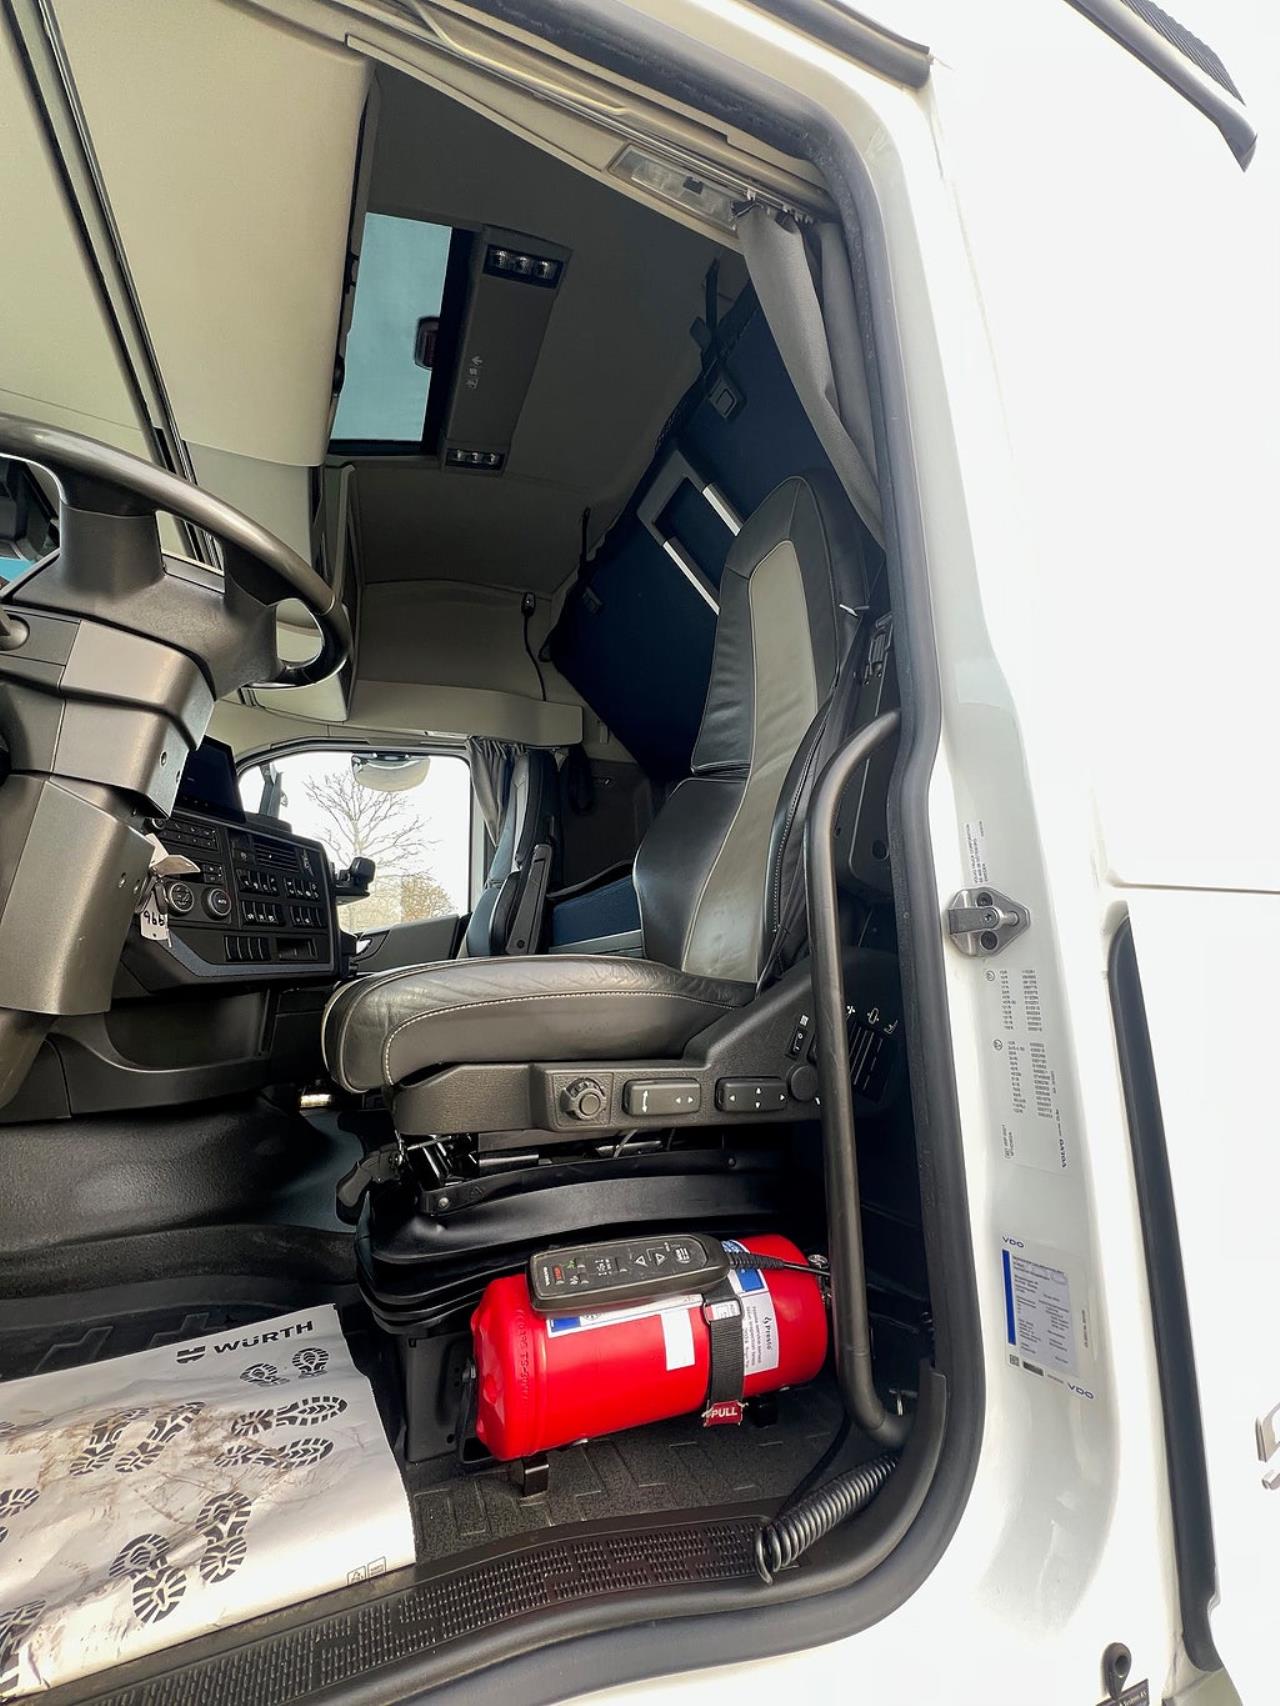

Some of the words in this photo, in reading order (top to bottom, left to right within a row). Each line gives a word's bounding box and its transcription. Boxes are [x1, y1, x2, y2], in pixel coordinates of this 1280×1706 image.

[1002, 1236, 1024, 1248] VDO
[213, 1320, 314, 1354] WÜRTH
[1067, 1382, 1094, 1400] VDO
[711, 1407, 738, 1418] PULL
